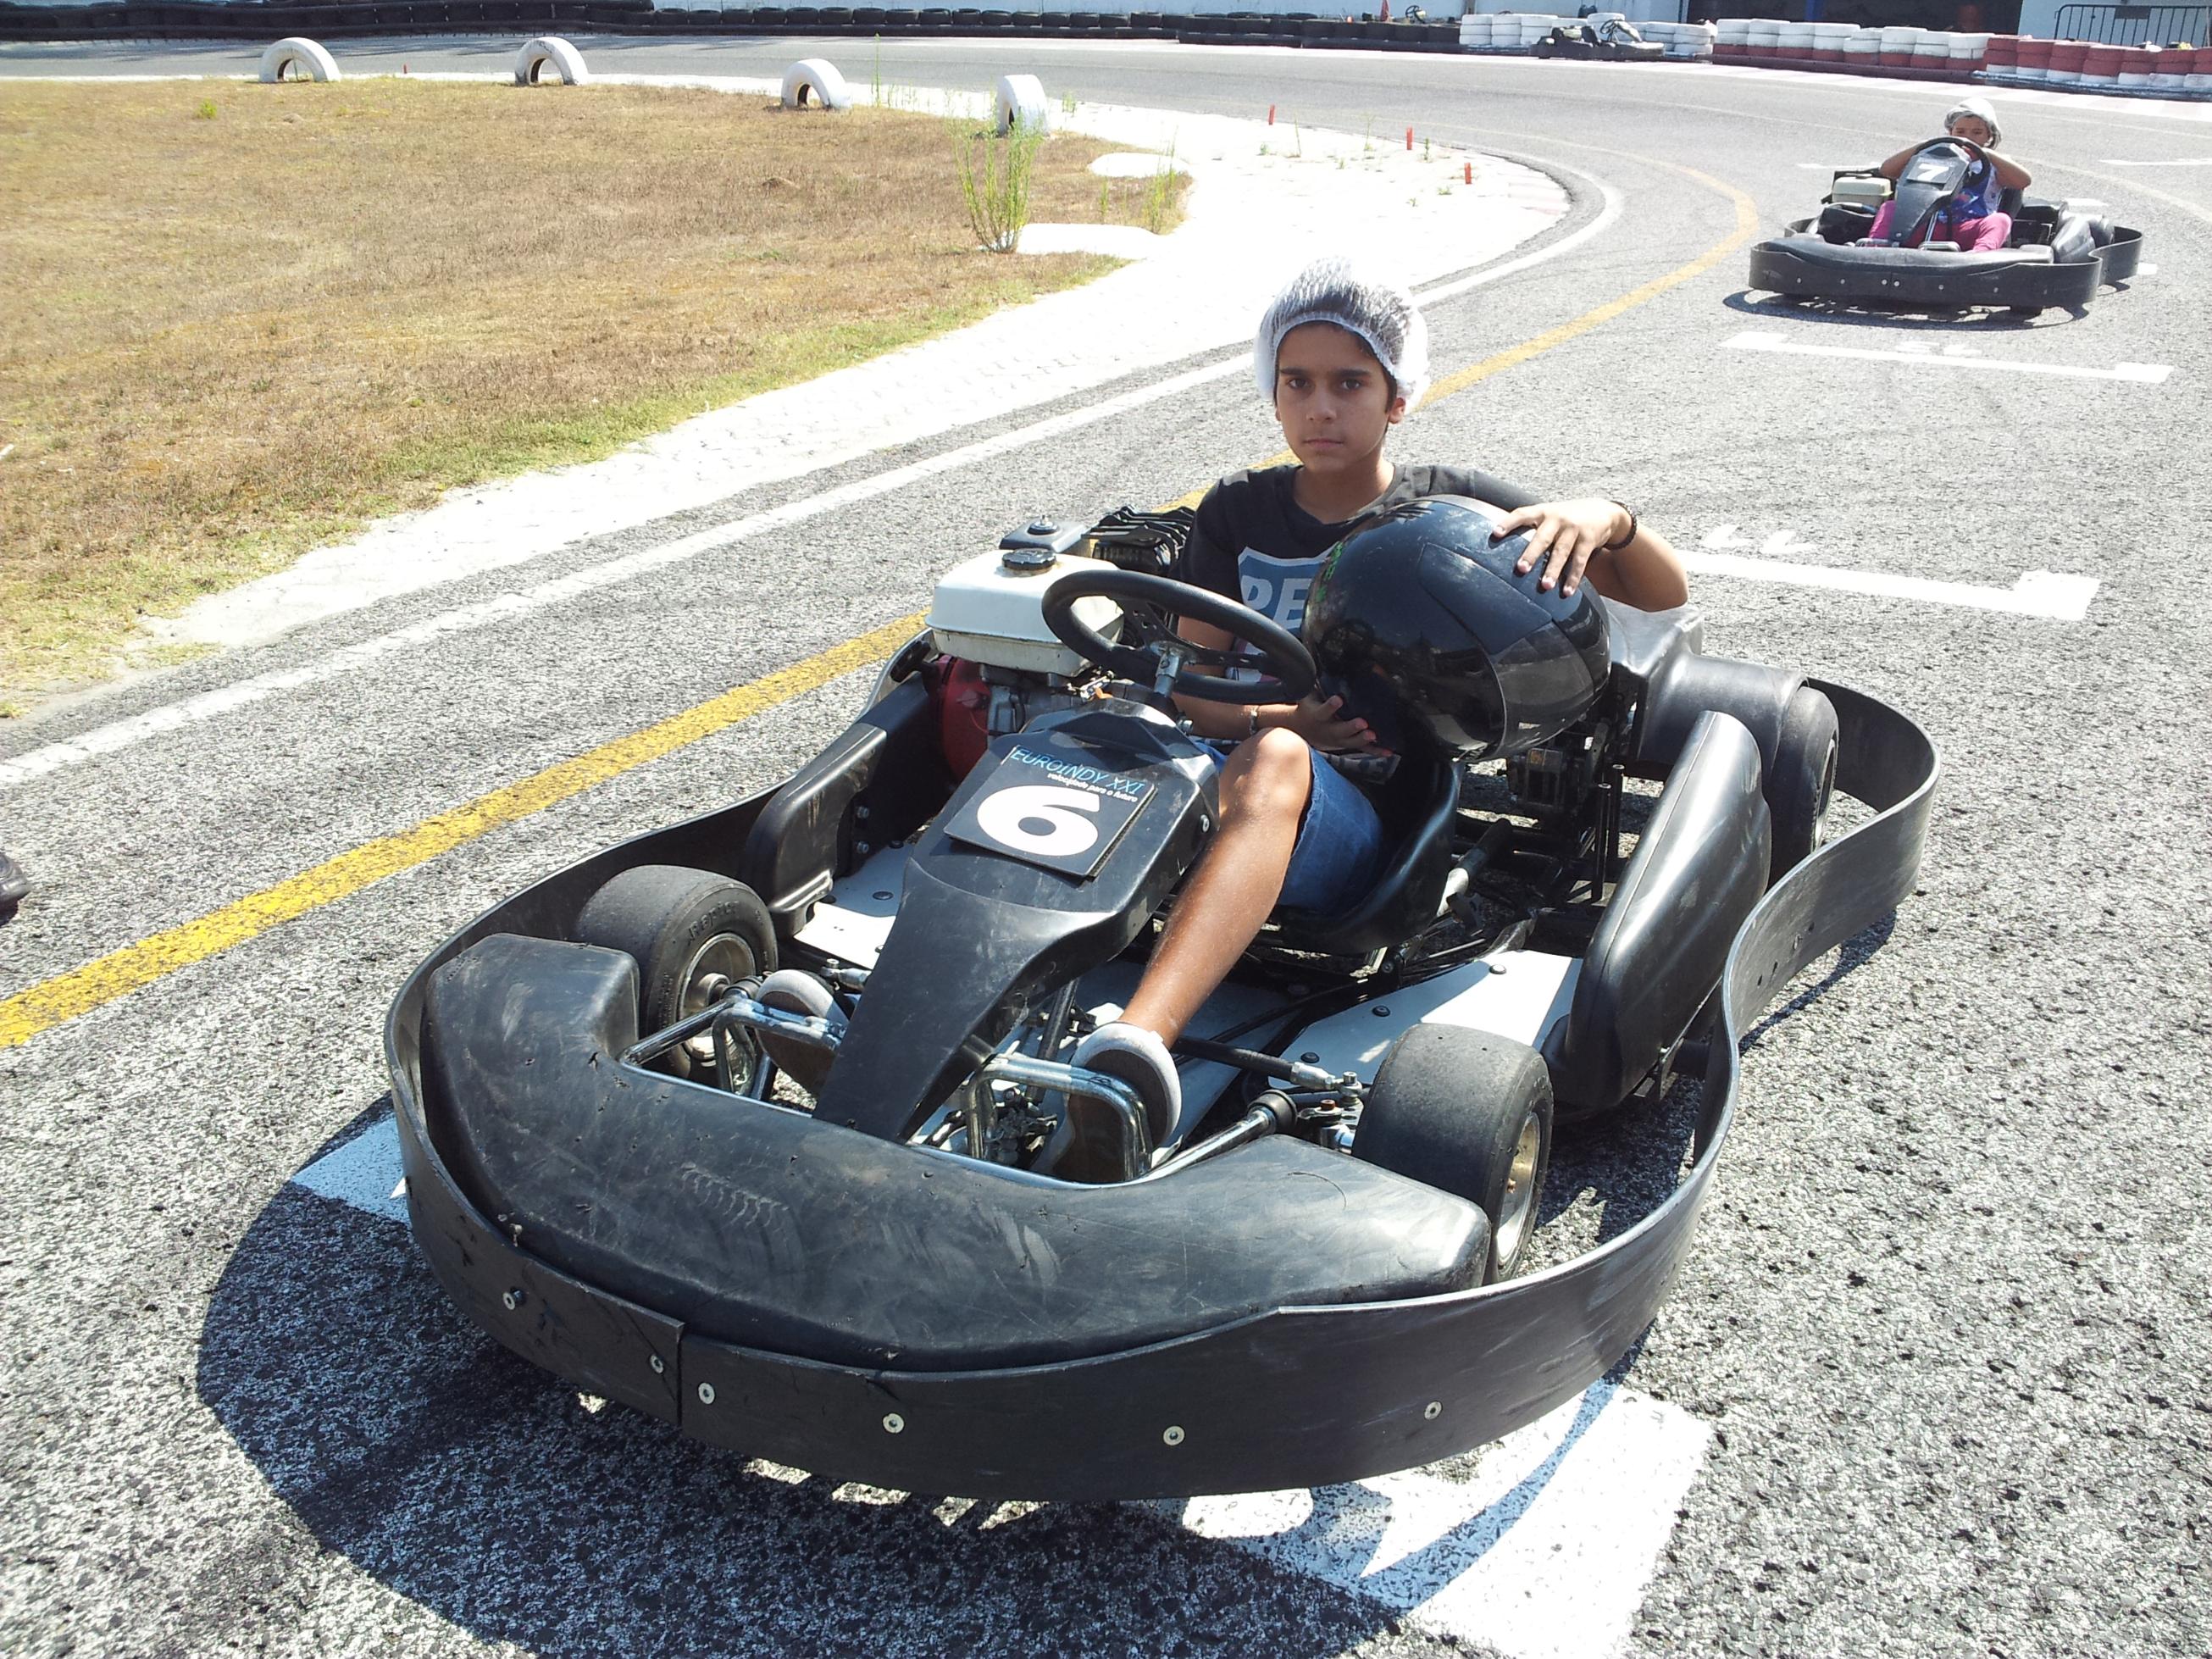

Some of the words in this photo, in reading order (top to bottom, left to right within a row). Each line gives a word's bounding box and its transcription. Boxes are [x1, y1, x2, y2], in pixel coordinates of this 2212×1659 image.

[1917, 163, 1949, 181] 7
[1011, 748, 1109, 784] EUROINDY
[1106, 778, 1145, 794] XXI
[1113, 791, 1138, 802] futuro
[977, 785, 1100, 856] 6
